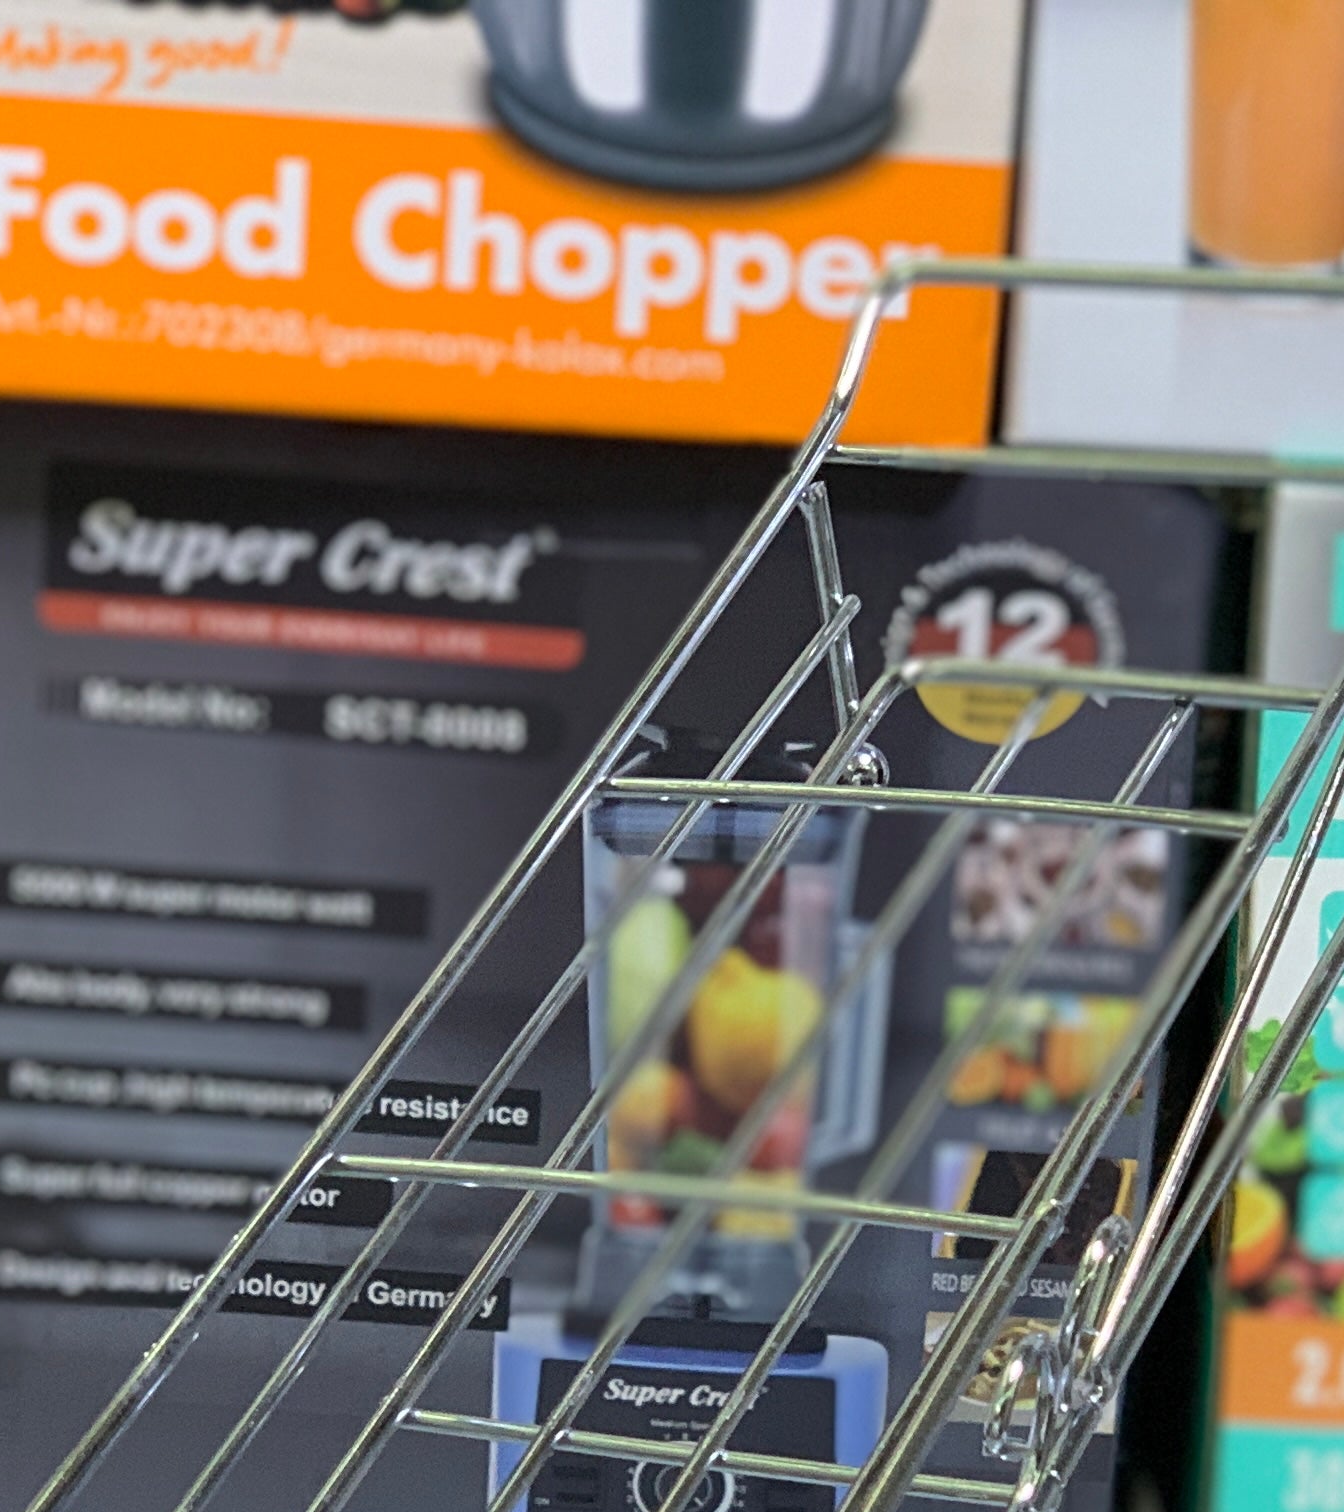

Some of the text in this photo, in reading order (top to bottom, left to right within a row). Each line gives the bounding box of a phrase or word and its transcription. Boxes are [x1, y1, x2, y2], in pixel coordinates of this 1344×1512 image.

[352, 168, 940, 344] Chopper
[67, 500, 316, 595] Super
[934, 585, 1074, 664] 12
[380, 1096, 531, 1127] resistce
[164, 1270, 328, 1307] tecology
[367, 1280, 498, 1319] Germy
[604, 1378, 758, 1411] Super Crt
